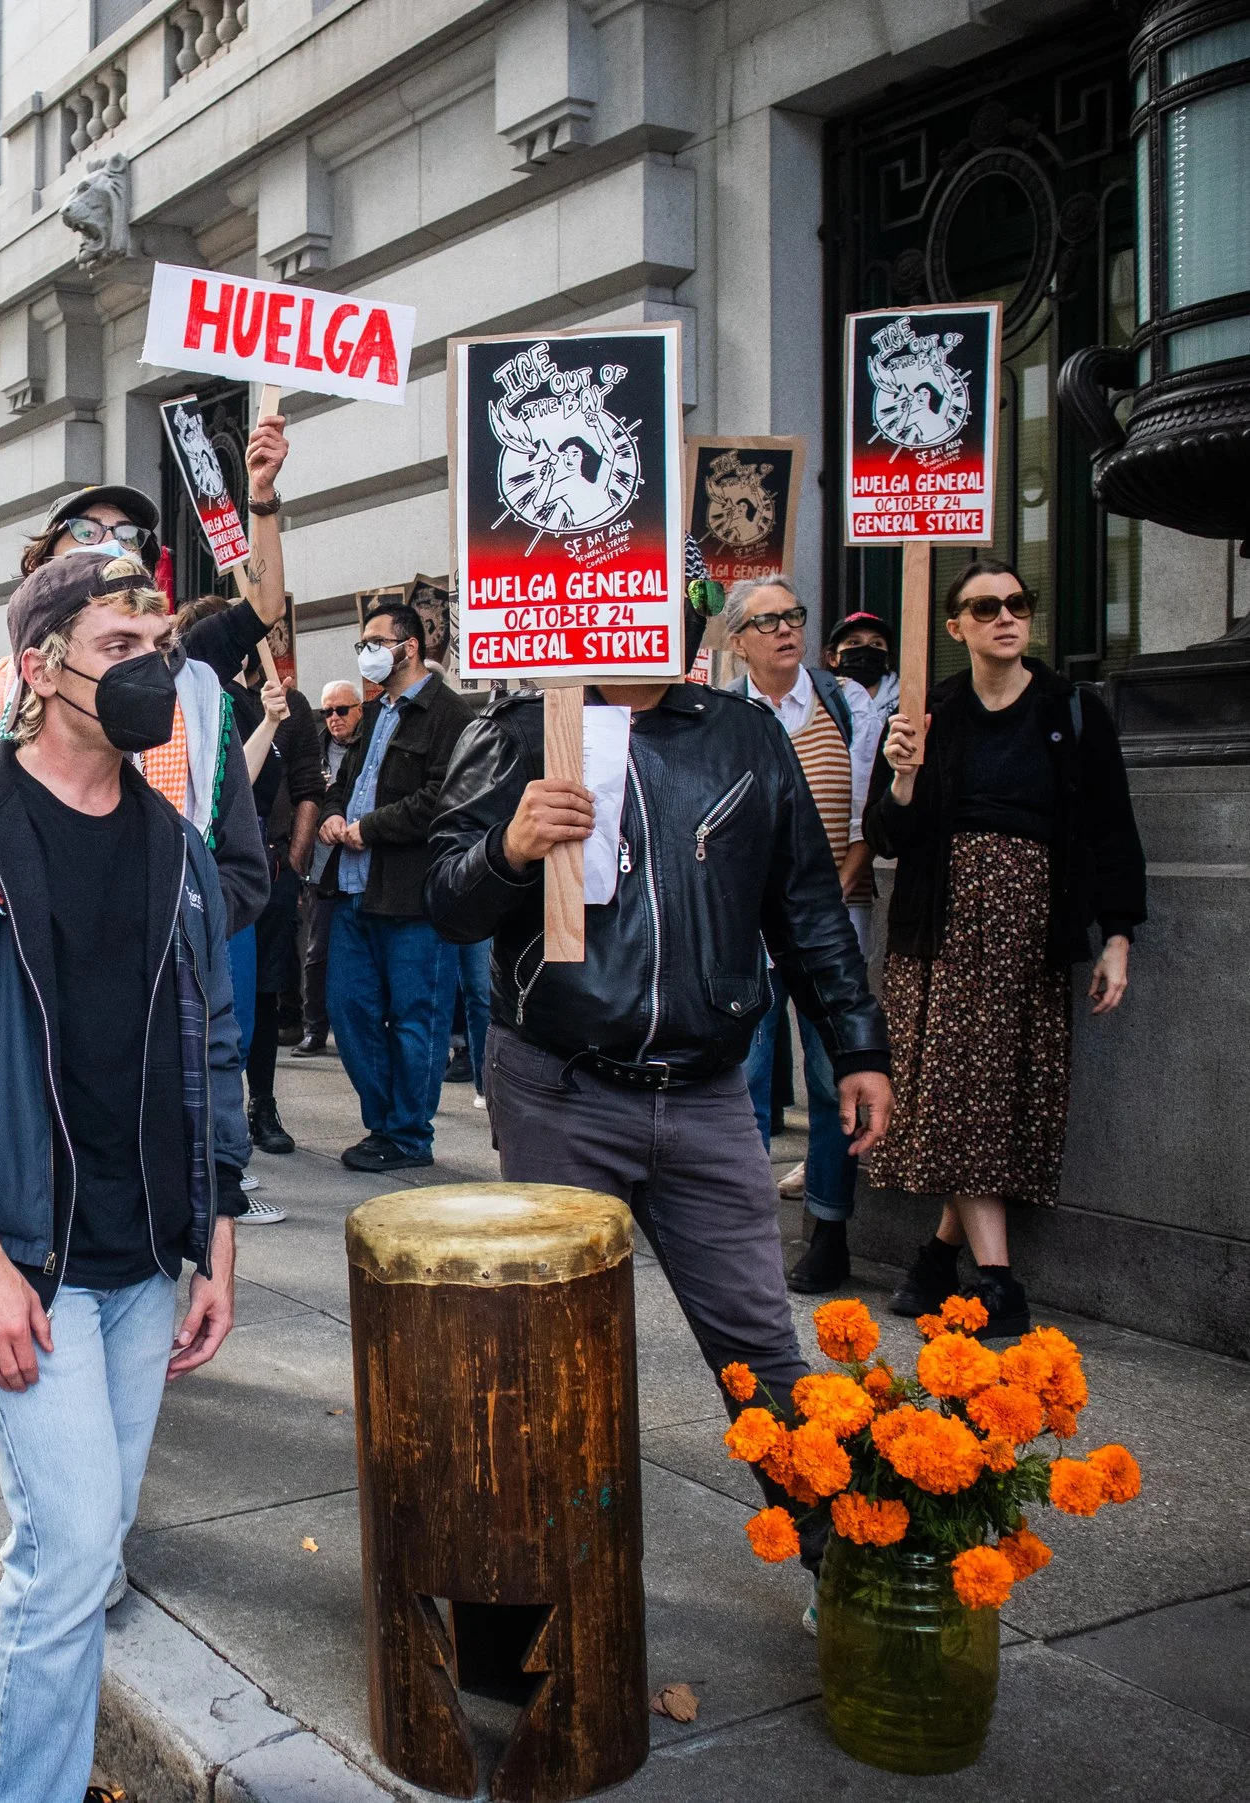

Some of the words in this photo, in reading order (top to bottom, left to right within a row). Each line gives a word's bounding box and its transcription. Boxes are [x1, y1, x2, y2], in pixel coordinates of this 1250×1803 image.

[183, 278, 399, 386] HUELGA
[871, 316, 916, 361] ICE
[910, 334, 940, 354] OUT
[944, 333, 964, 347] OF
[916, 346, 953, 370] BAY
[493, 342, 557, 407] ICE
[549, 367, 592, 395] OUT
[600, 364, 628, 384] OF
[522, 397, 559, 419] THE
[560, 384, 613, 420] BAY
[915, 451, 928, 464] SF
[930, 446, 944, 459] BAY
[945, 438, 963, 451] AREA
[853, 474, 909, 494] HUELGA
[915, 472, 984, 493] GENERAL
[875, 496, 937, 511] OCTOBER
[943, 496, 960, 509] 24
[855, 514, 919, 534] GENERAL
[925, 512, 981, 531] STRIKE
[564, 537, 582, 558] SF
[586, 530, 605, 549] BAY
[608, 520, 634, 537] AREA
[575, 547, 605, 565] GENERAL
[606, 534, 630, 550] STRIKE
[586, 543, 630, 569] COMMITTEE
[470, 573, 557, 605] HUELGA
[566, 569, 668, 599] GENERAL
[504, 605, 599, 630] OCTOBER
[608, 605, 634, 626] 24
[472, 632, 573, 664] GENERAL
[582, 630, 666, 658] STRIKE
